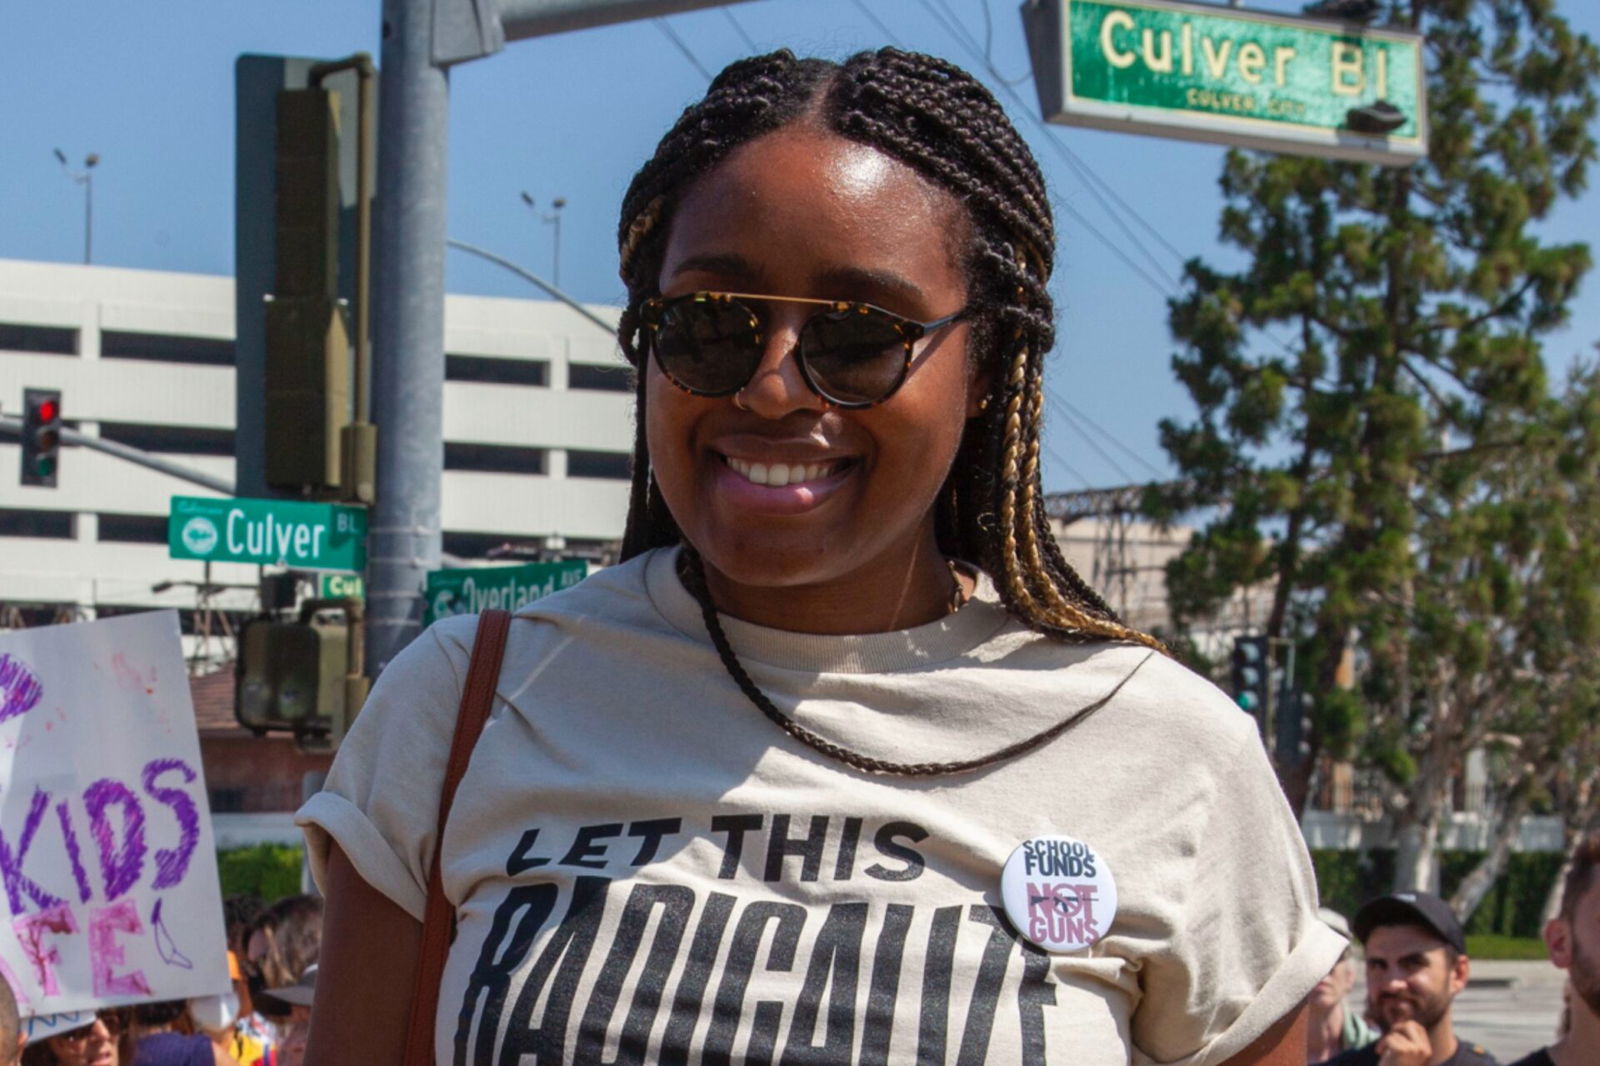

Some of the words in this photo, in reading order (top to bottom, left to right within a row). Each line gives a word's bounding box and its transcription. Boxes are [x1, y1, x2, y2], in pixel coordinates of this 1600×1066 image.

[1101, 10, 1296, 88] Culver
[1186, 87, 1254, 111] CULVER
[226, 508, 325, 558] Culver
[0, 757, 199, 916] KIDS
[506, 818, 681, 876] LET
[711, 814, 929, 882] THIS
[1022, 840, 1095, 859] SCHOOL
[1024, 852, 1096, 878] FUNDS
[1026, 882, 1098, 920] NOT
[0, 898, 153, 1003] FE
[1029, 917, 1100, 945] GUNS
